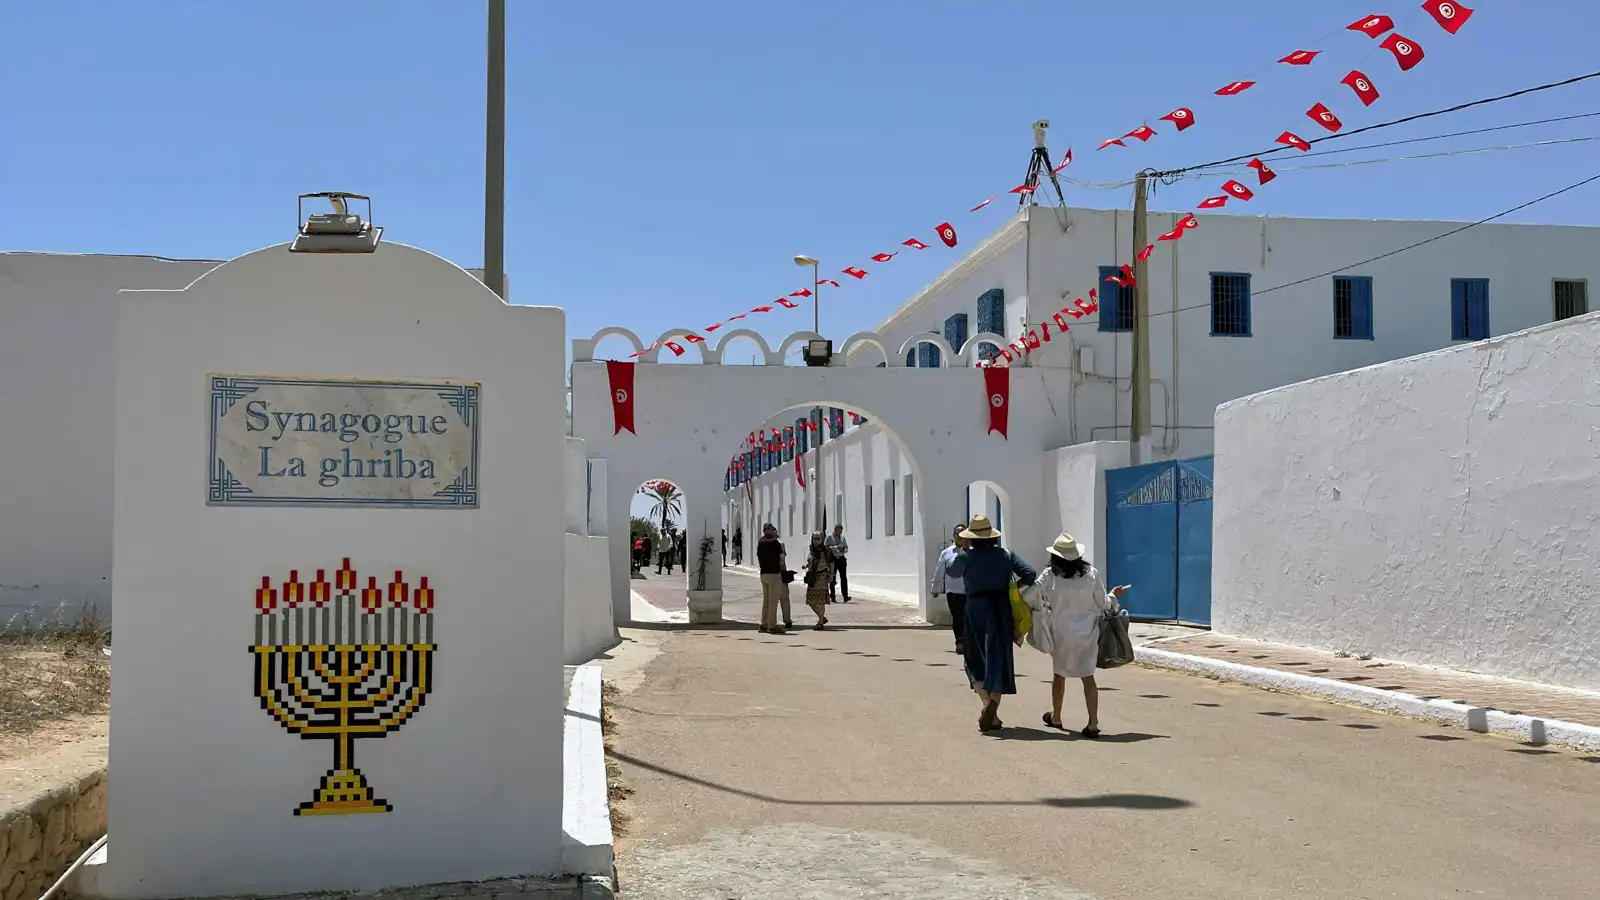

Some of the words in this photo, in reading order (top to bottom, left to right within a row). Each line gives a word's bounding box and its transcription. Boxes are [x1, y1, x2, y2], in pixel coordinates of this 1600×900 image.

[245, 400, 448, 443] Synagogue
[257, 446, 307, 477] La
[318, 448, 436, 487] ghriba
